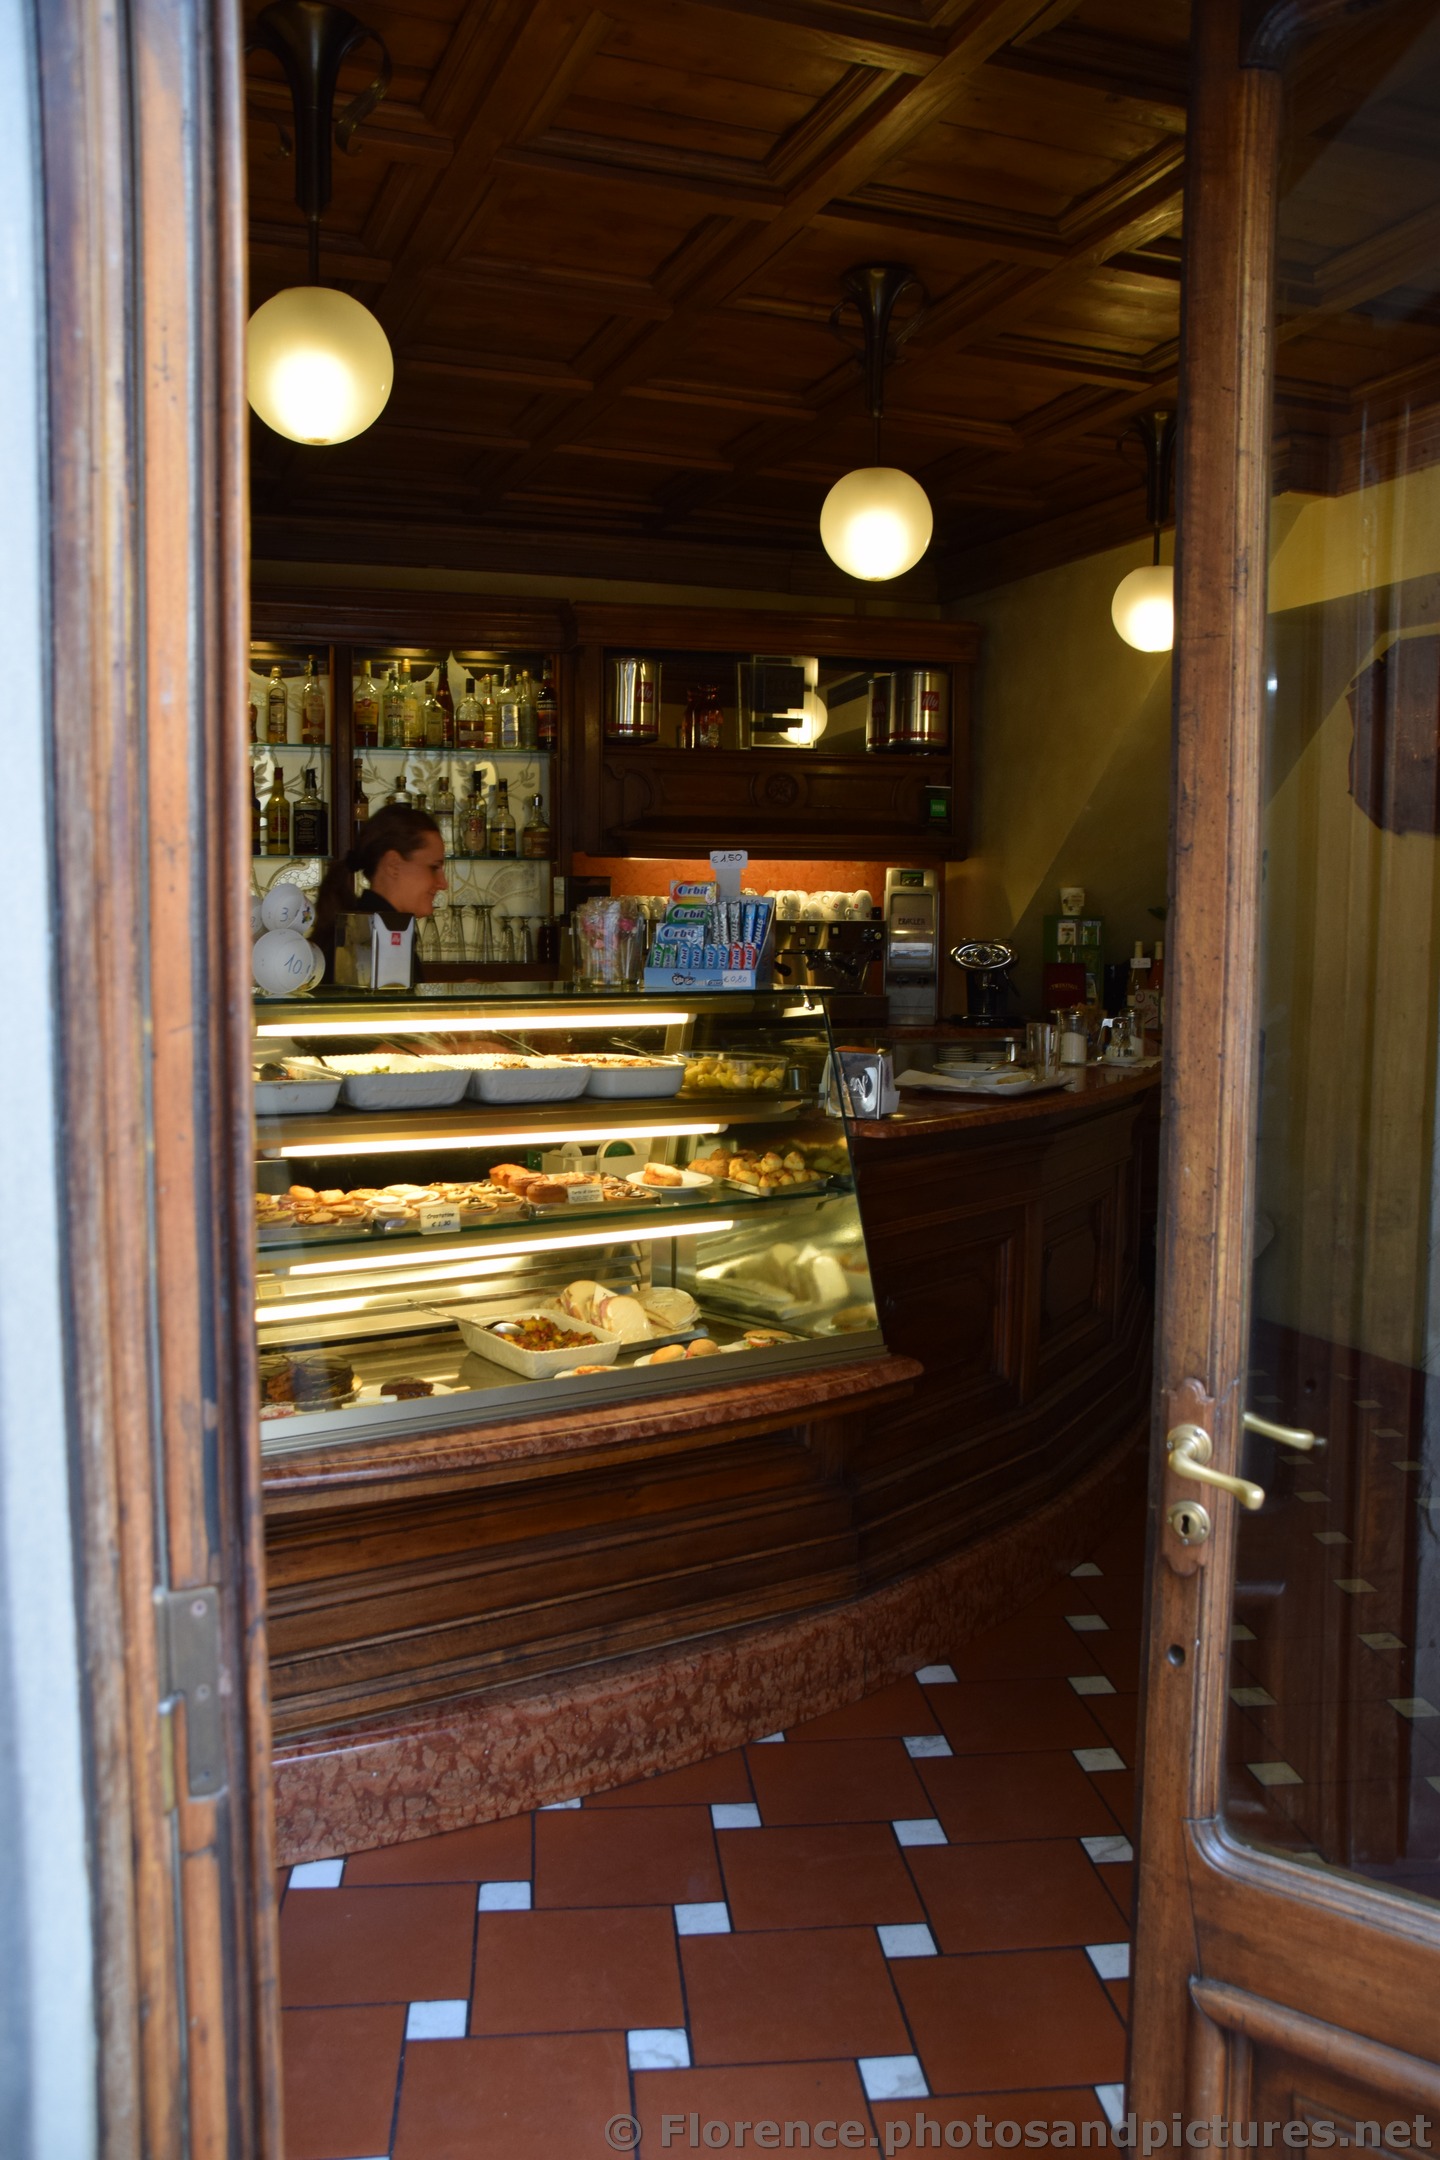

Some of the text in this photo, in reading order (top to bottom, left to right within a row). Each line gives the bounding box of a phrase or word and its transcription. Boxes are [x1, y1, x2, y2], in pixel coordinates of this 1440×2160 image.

[922, 694, 939, 709] illy
[677, 885, 709, 895] Orbit
[673, 909, 705, 919] Orbit
[663, 928, 696, 938] Orbit
[754, 918, 764, 944] HALLS
